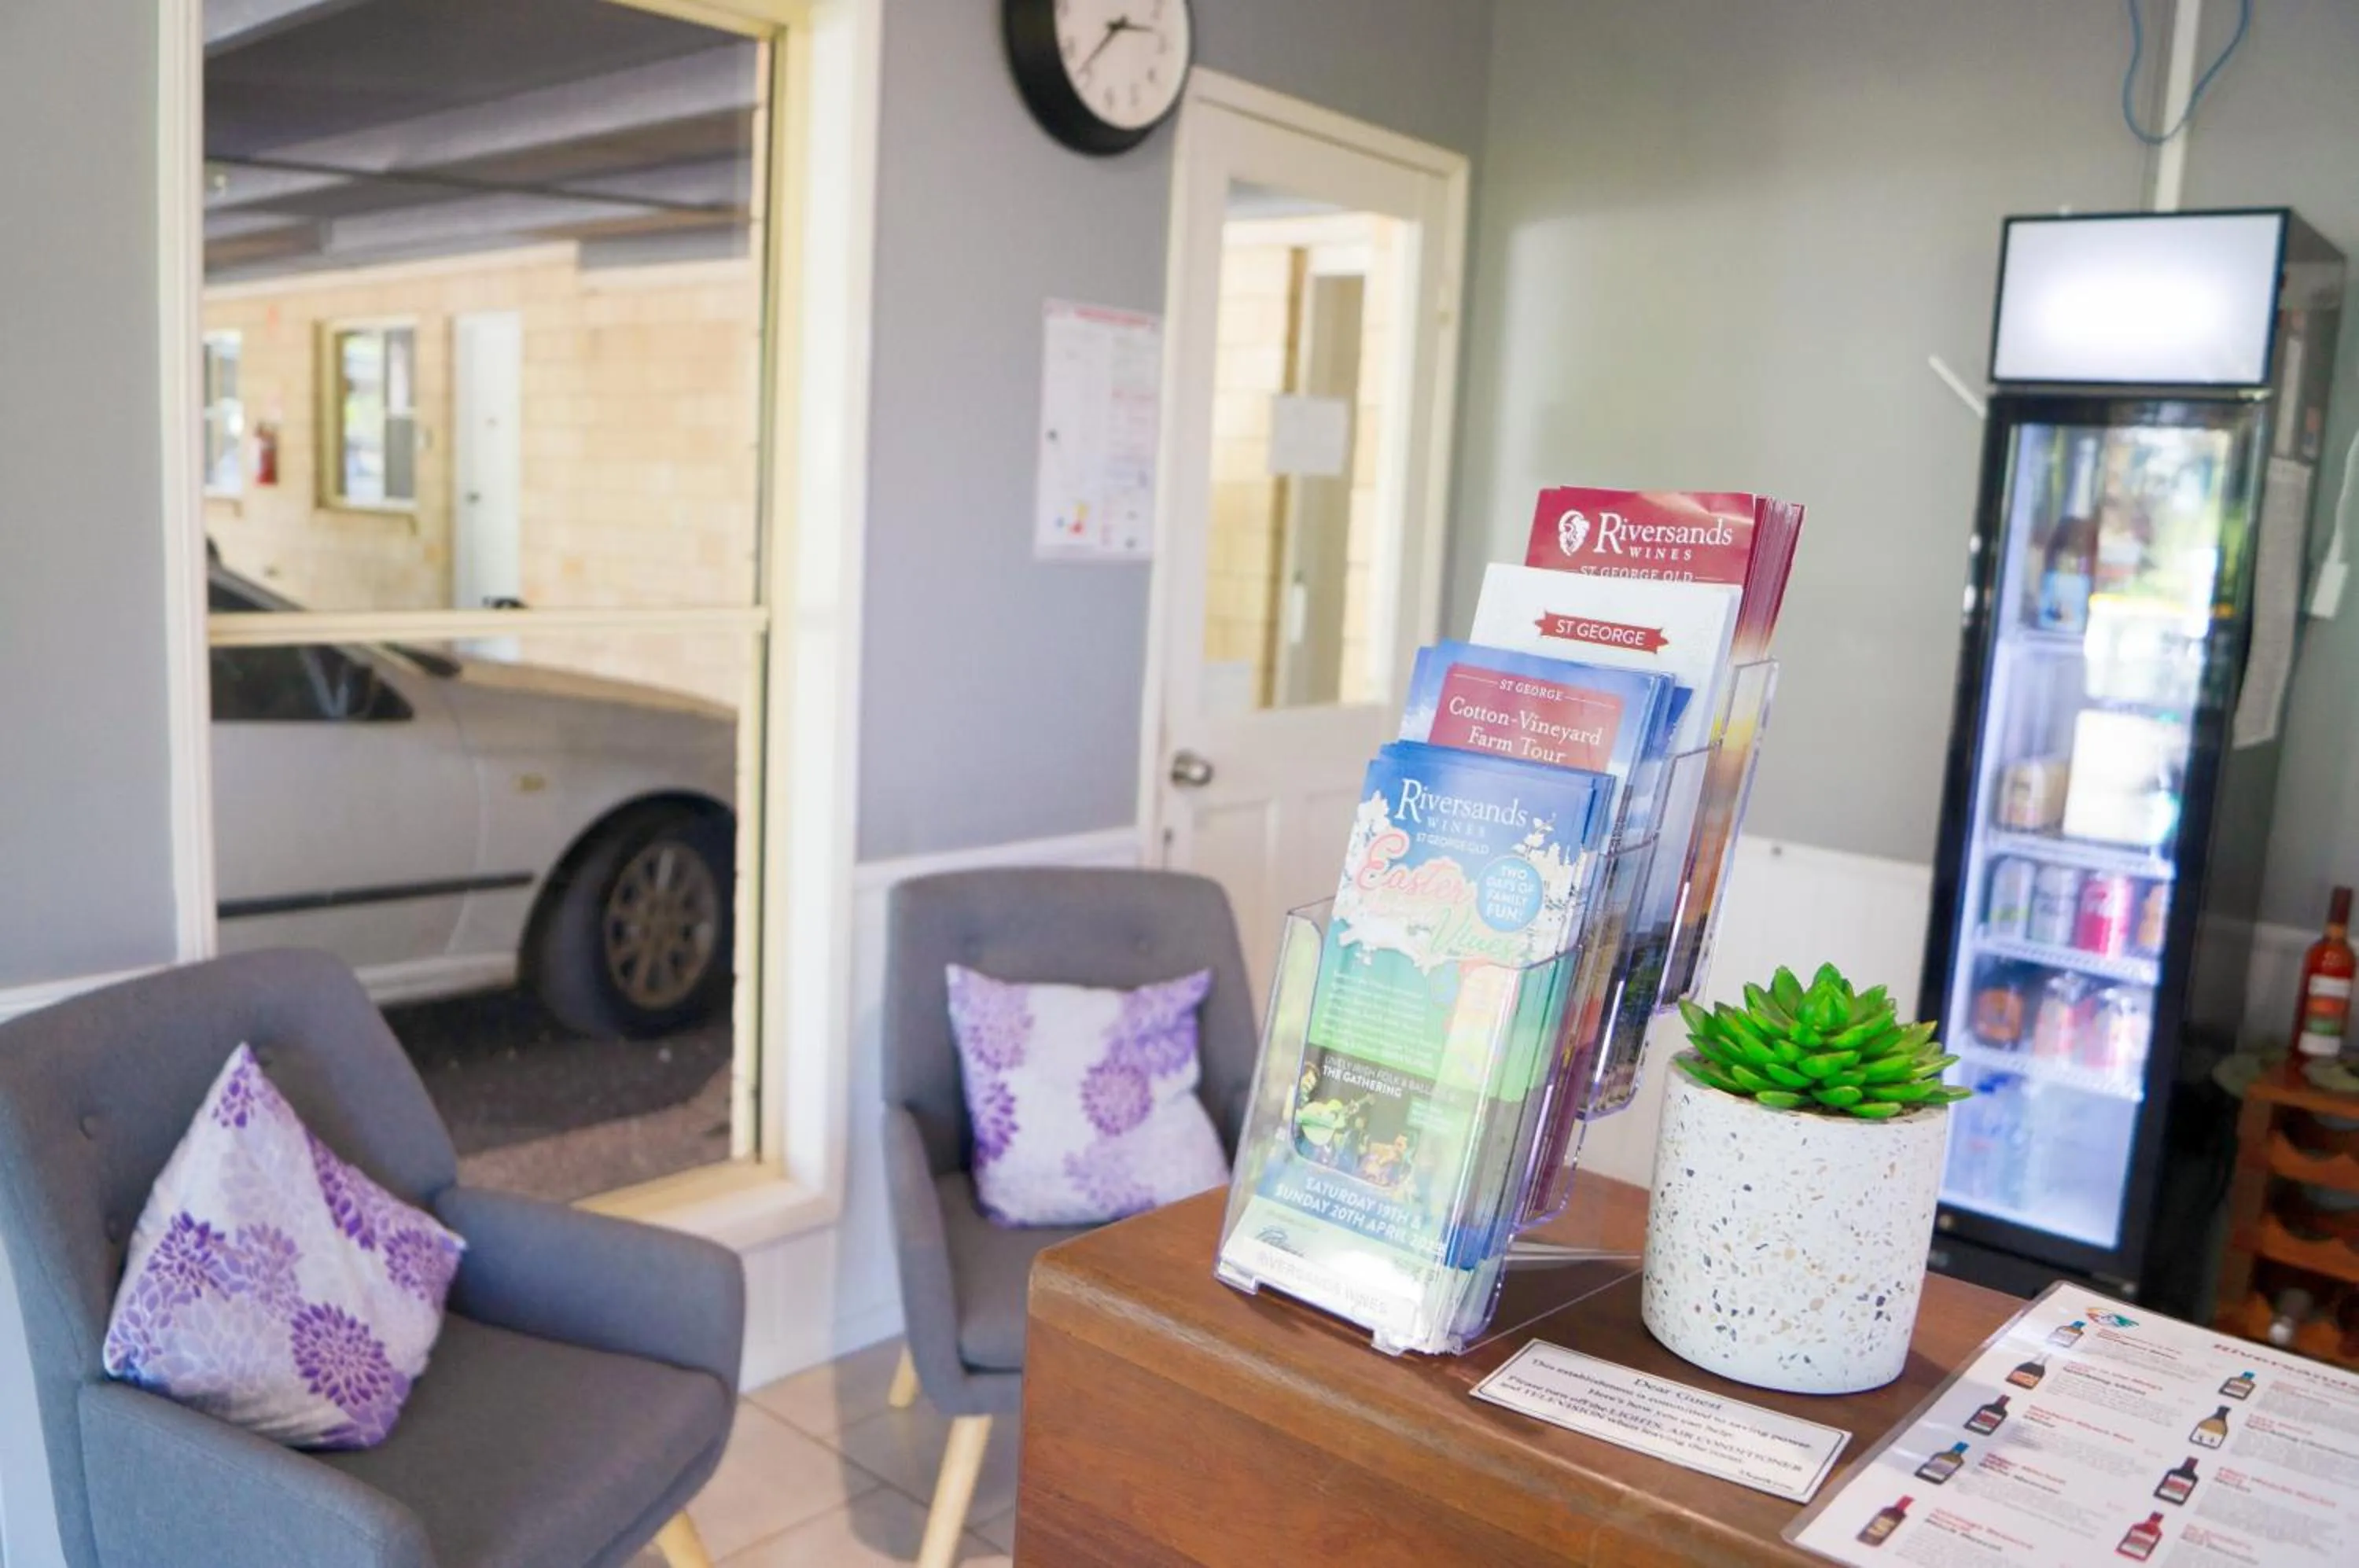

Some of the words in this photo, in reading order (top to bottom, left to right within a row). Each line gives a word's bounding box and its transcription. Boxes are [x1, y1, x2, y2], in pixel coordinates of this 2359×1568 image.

[1592, 511, 1733, 554] Riversands
[1628, 547, 1692, 561] WINES
[1555, 618, 1575, 635] ST
[1576, 621, 1646, 646] GEORGE
[1500, 679, 1514, 691] ST
[1515, 682, 1564, 701] GEORGE
[1448, 695, 1603, 746] Cotton-Vineyard
[1468, 725, 1513, 753] Farm
[1520, 737, 1568, 764] Tour
[1394, 778, 1529, 826] Riversands
[1426, 816, 1485, 837] WINES
[1502, 866, 1528, 880] TWO
[1323, 1065, 1341, 1080] THE
[1341, 1070, 1403, 1099] GATHERING
[1305, 1178, 1375, 1211] SATURDAY
[1275, 1183, 1330, 1215] SUNDAY
[1330, 1205, 1367, 1226] 20TH
[1364, 1217, 1406, 1243] APRIL
[1632, 1378, 1672, 1394] Dear
[1673, 1391, 1722, 1410] Guest
